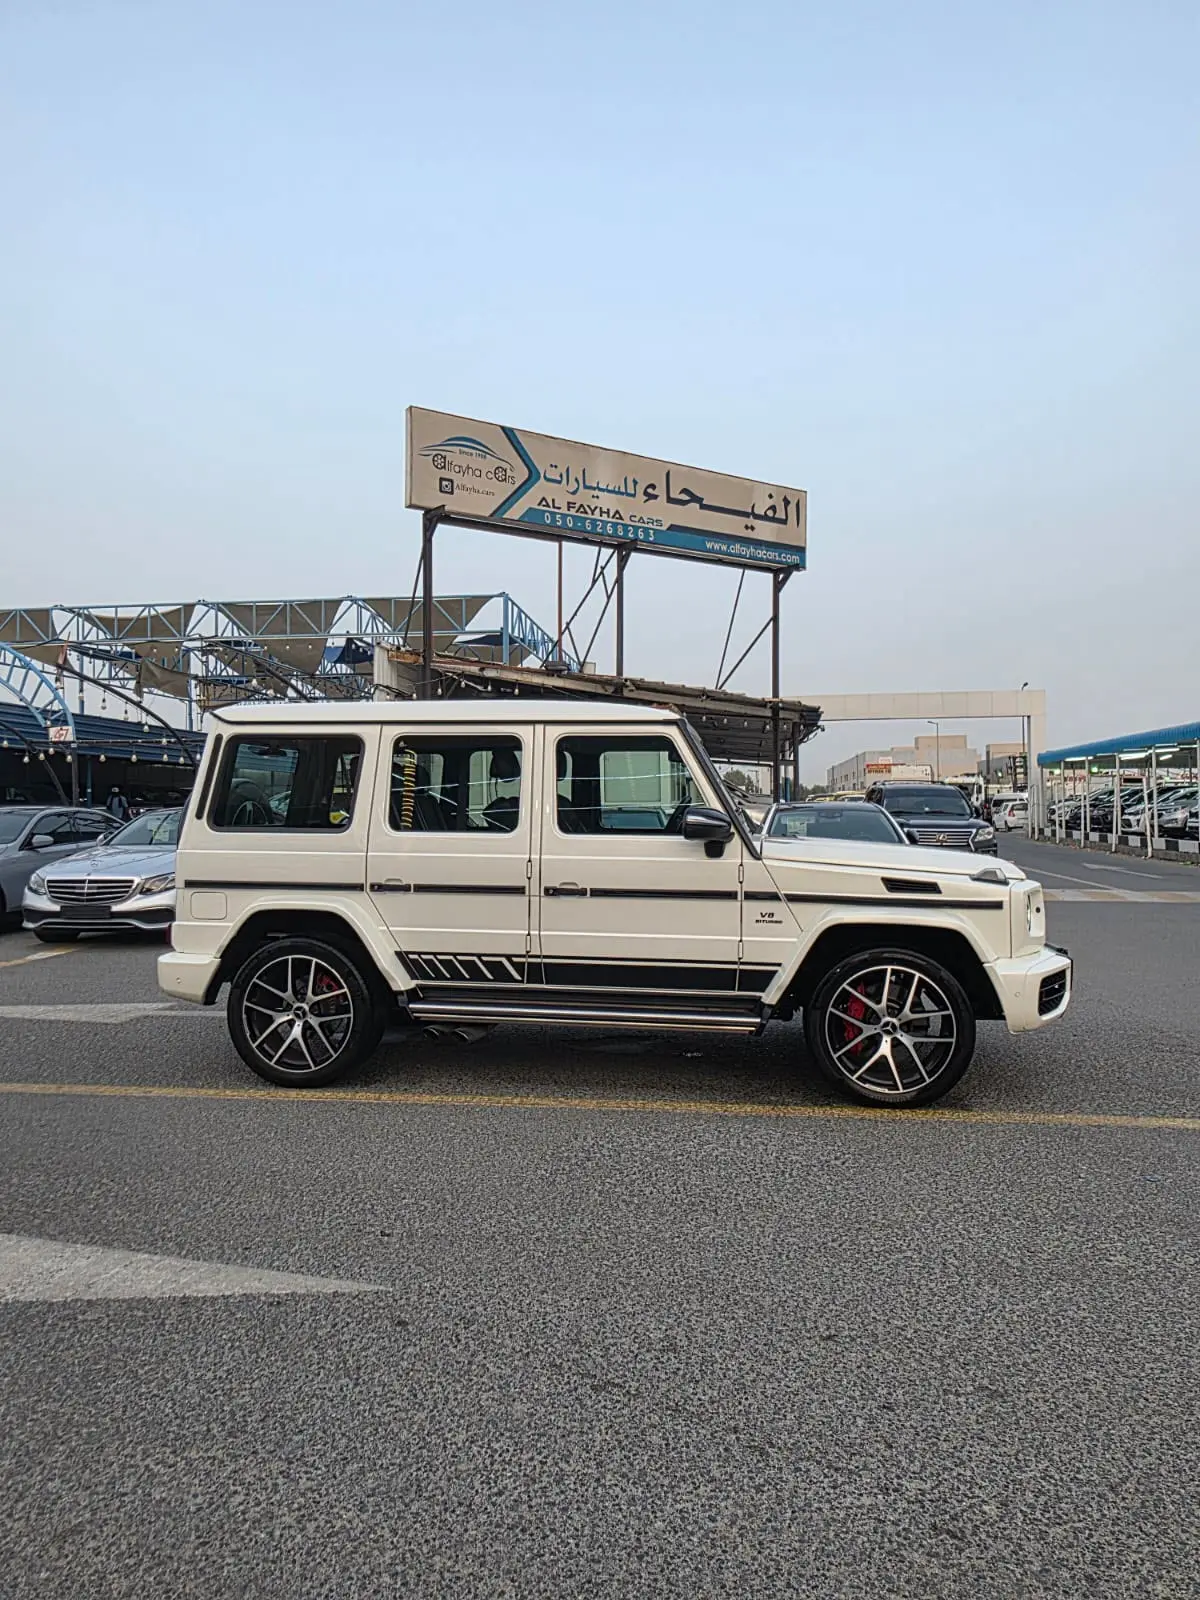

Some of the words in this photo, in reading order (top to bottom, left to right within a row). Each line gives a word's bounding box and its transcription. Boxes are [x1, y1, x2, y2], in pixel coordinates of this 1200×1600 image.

[432, 453, 482, 478] alfayha
[485, 466, 516, 485] cars
[543, 463, 639, 499] للسيارات
[537, 496, 562, 510] AL
[566, 501, 625, 521] FAYHA
[629, 514, 664, 527] CARS
[705, 540, 800, 564] www.alfayhacars.com
[760, 911, 775, 919] V8
